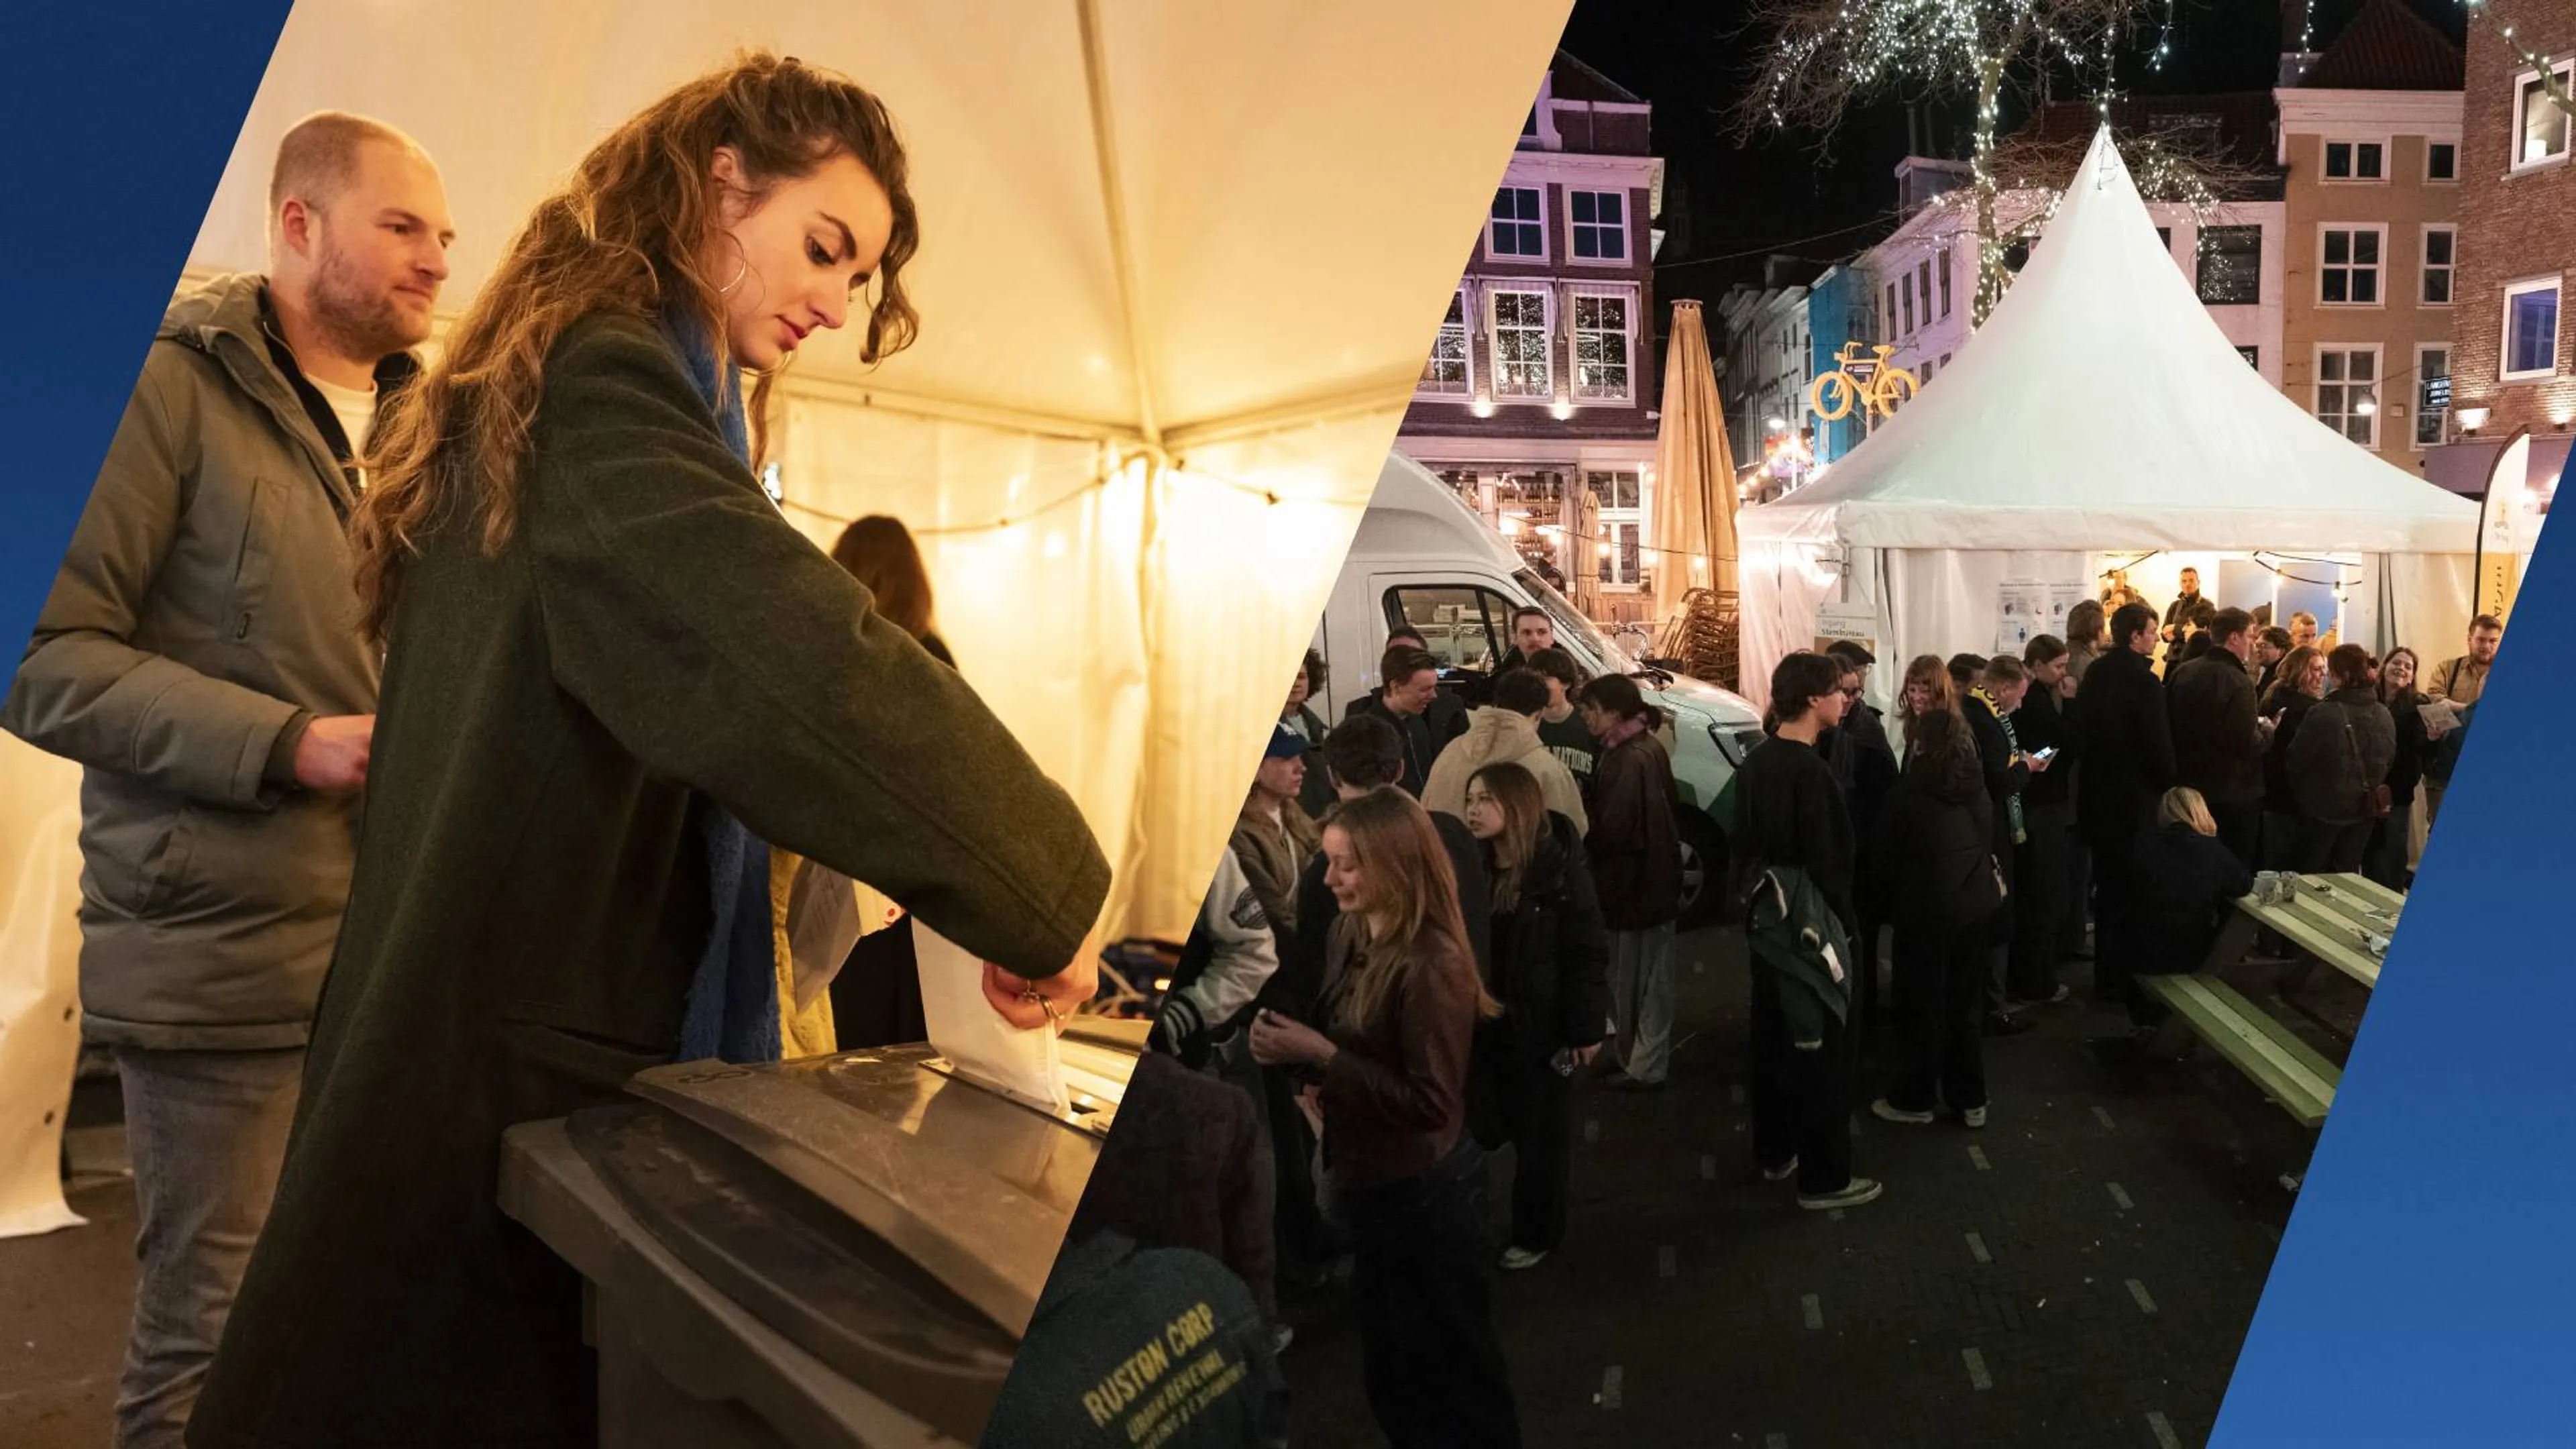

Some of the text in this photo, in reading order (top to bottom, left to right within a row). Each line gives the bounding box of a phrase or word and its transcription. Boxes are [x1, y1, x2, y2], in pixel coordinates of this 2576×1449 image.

[1821, 629, 1864, 637] Stembureau
[1081, 1336, 1169, 1428] RUSTON
[1166, 1301, 1215, 1358] CORP
